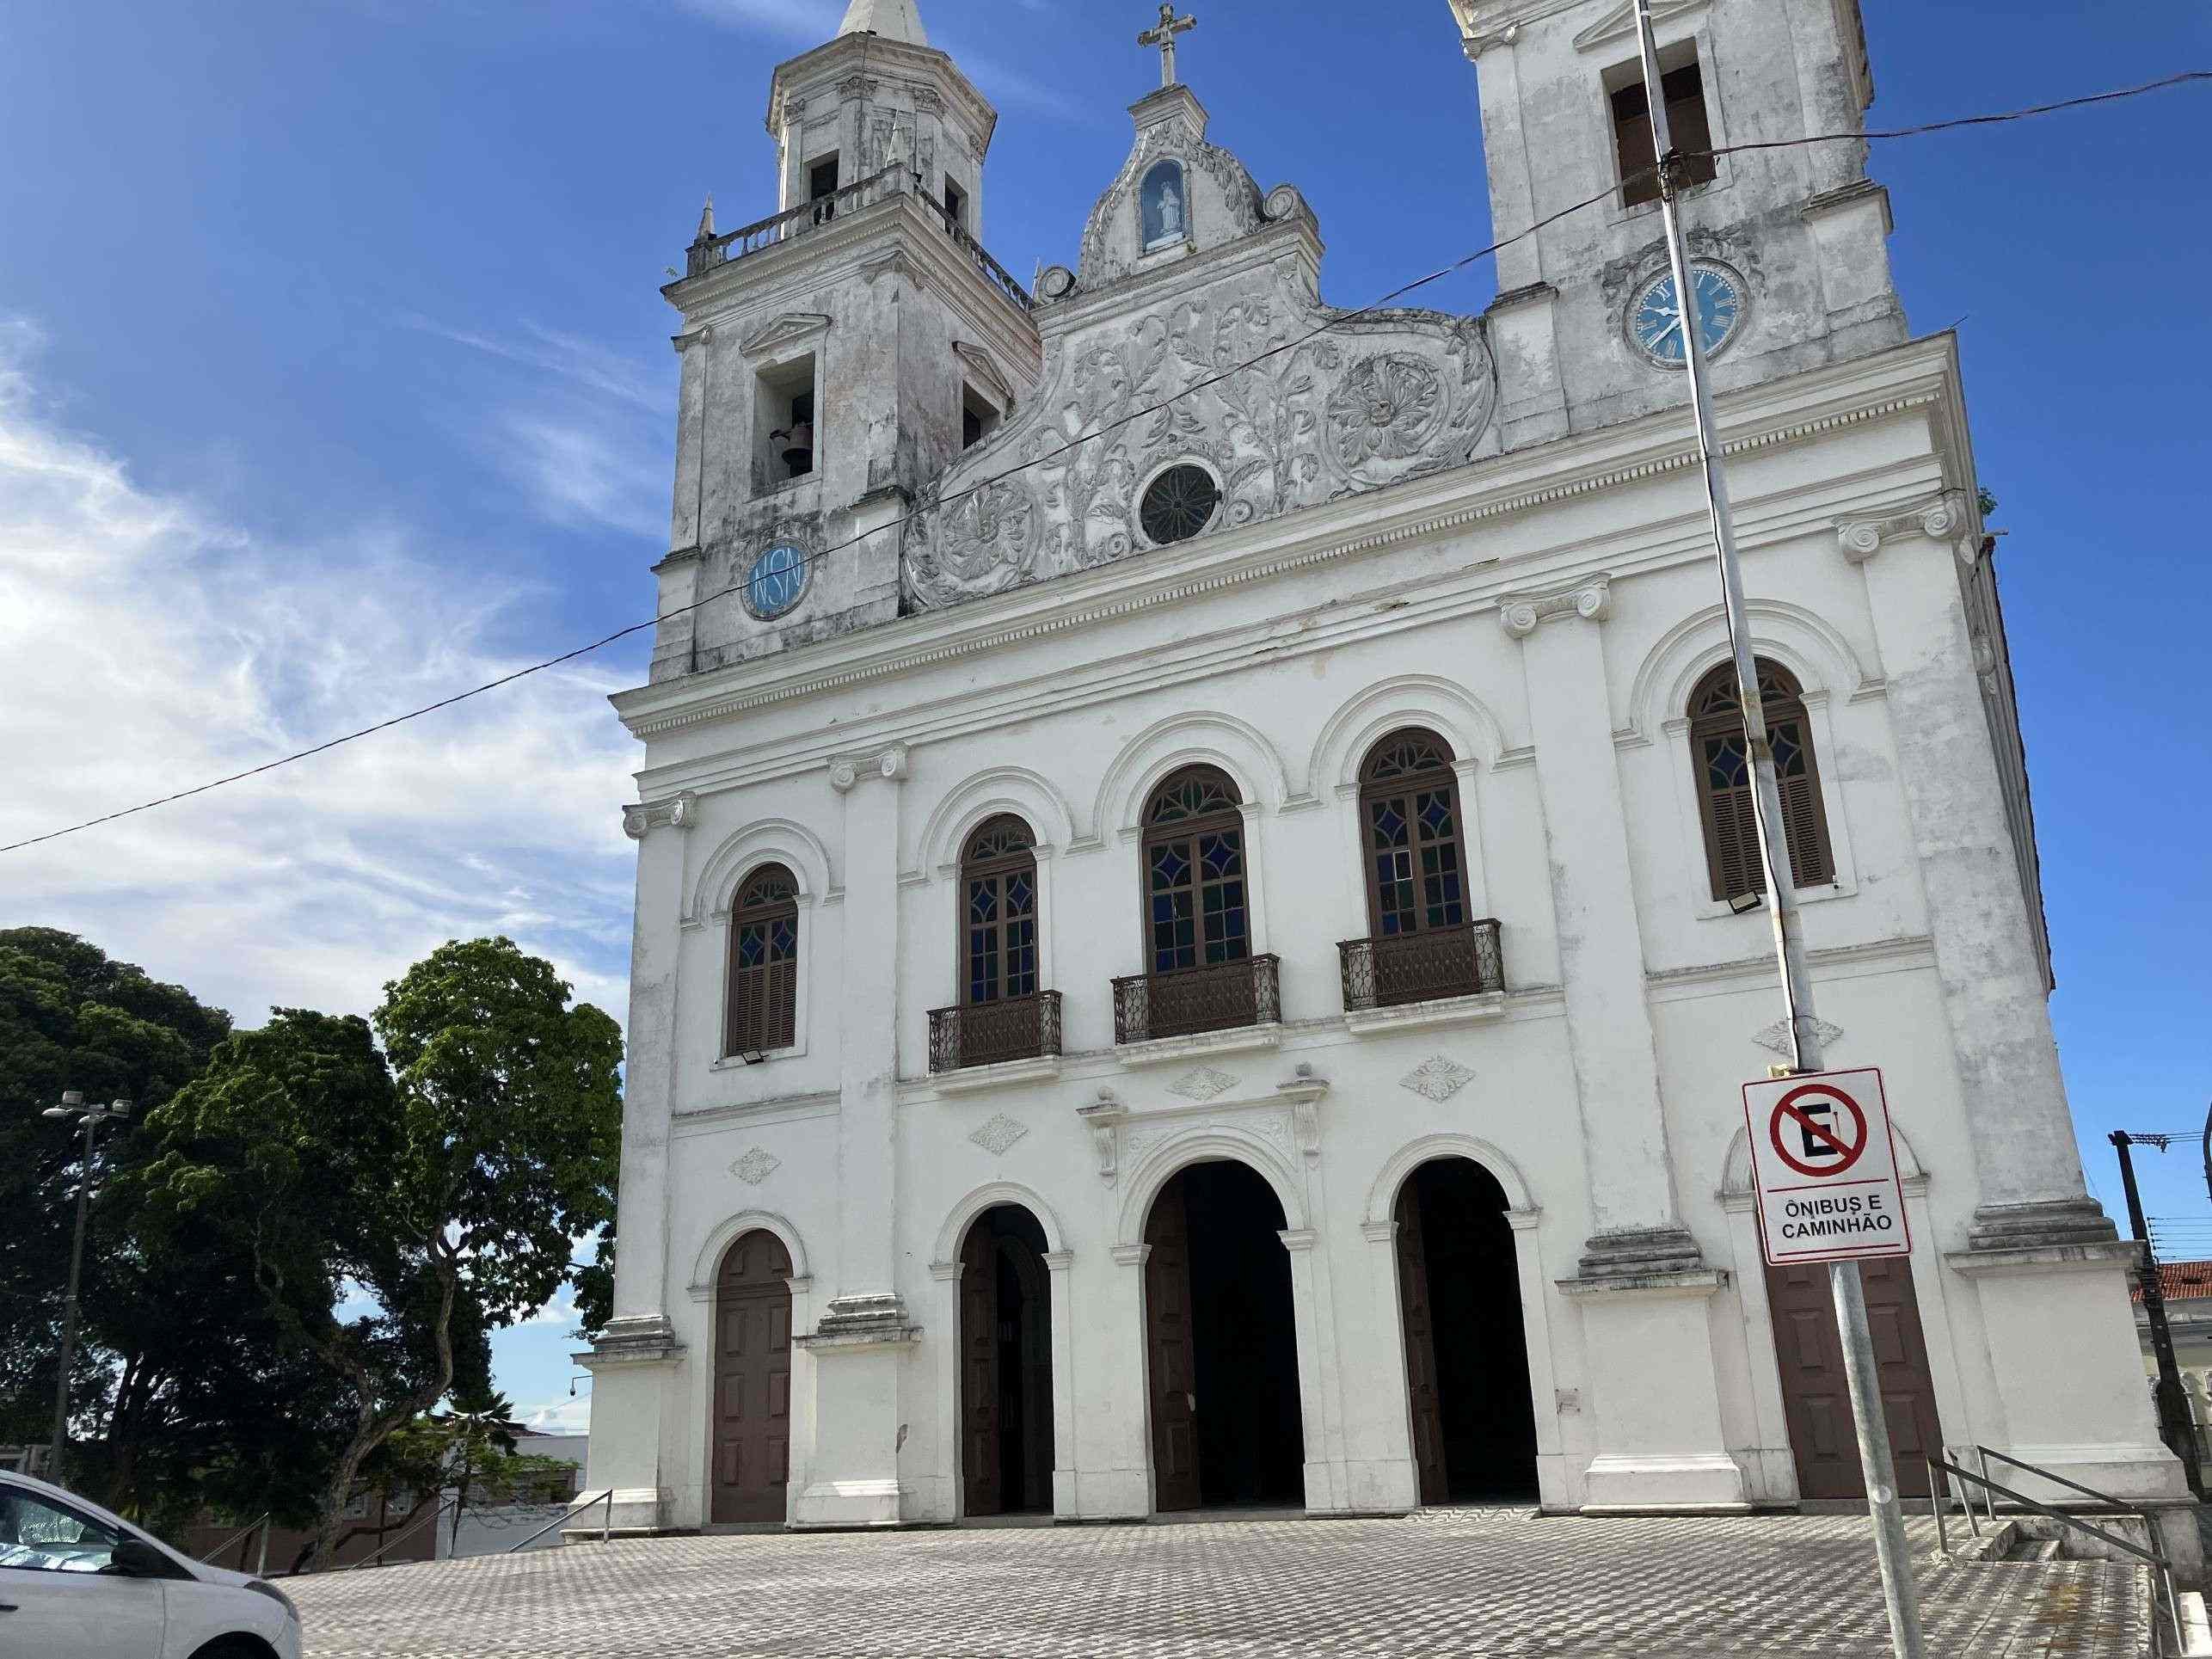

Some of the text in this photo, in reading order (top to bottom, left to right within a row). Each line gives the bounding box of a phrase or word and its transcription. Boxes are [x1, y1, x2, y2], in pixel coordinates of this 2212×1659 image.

[1797, 1103, 1838, 1157] E
[1785, 1195, 1883, 1218] ÔNIBUS E
[1782, 1214, 1892, 1238] CAMINHÃO
